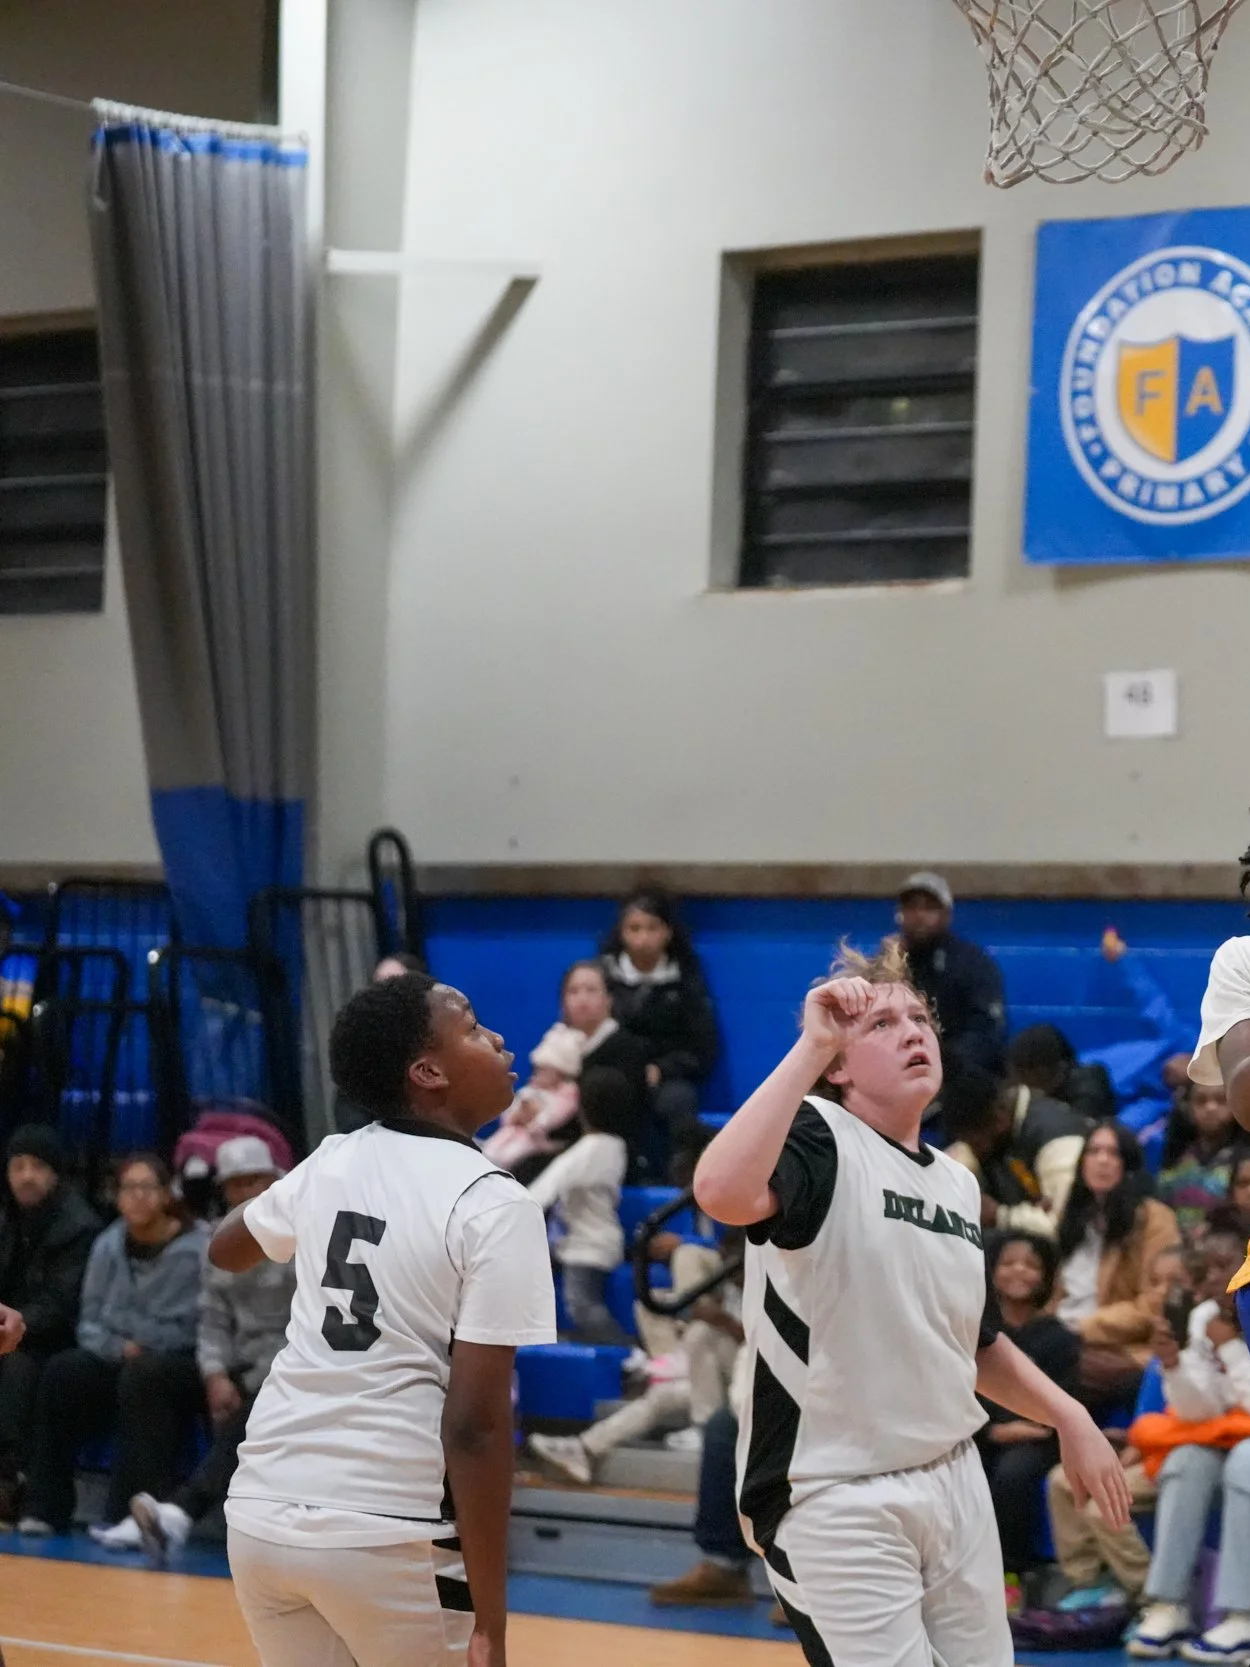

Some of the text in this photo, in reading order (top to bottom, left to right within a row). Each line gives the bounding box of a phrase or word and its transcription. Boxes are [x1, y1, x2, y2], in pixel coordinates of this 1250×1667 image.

[1070, 260, 1202, 444] FOUNDATION
[1134, 366, 1224, 417] F A
[1100, 452, 1246, 511] PRIMARY
[320, 1210, 387, 1352] 5
